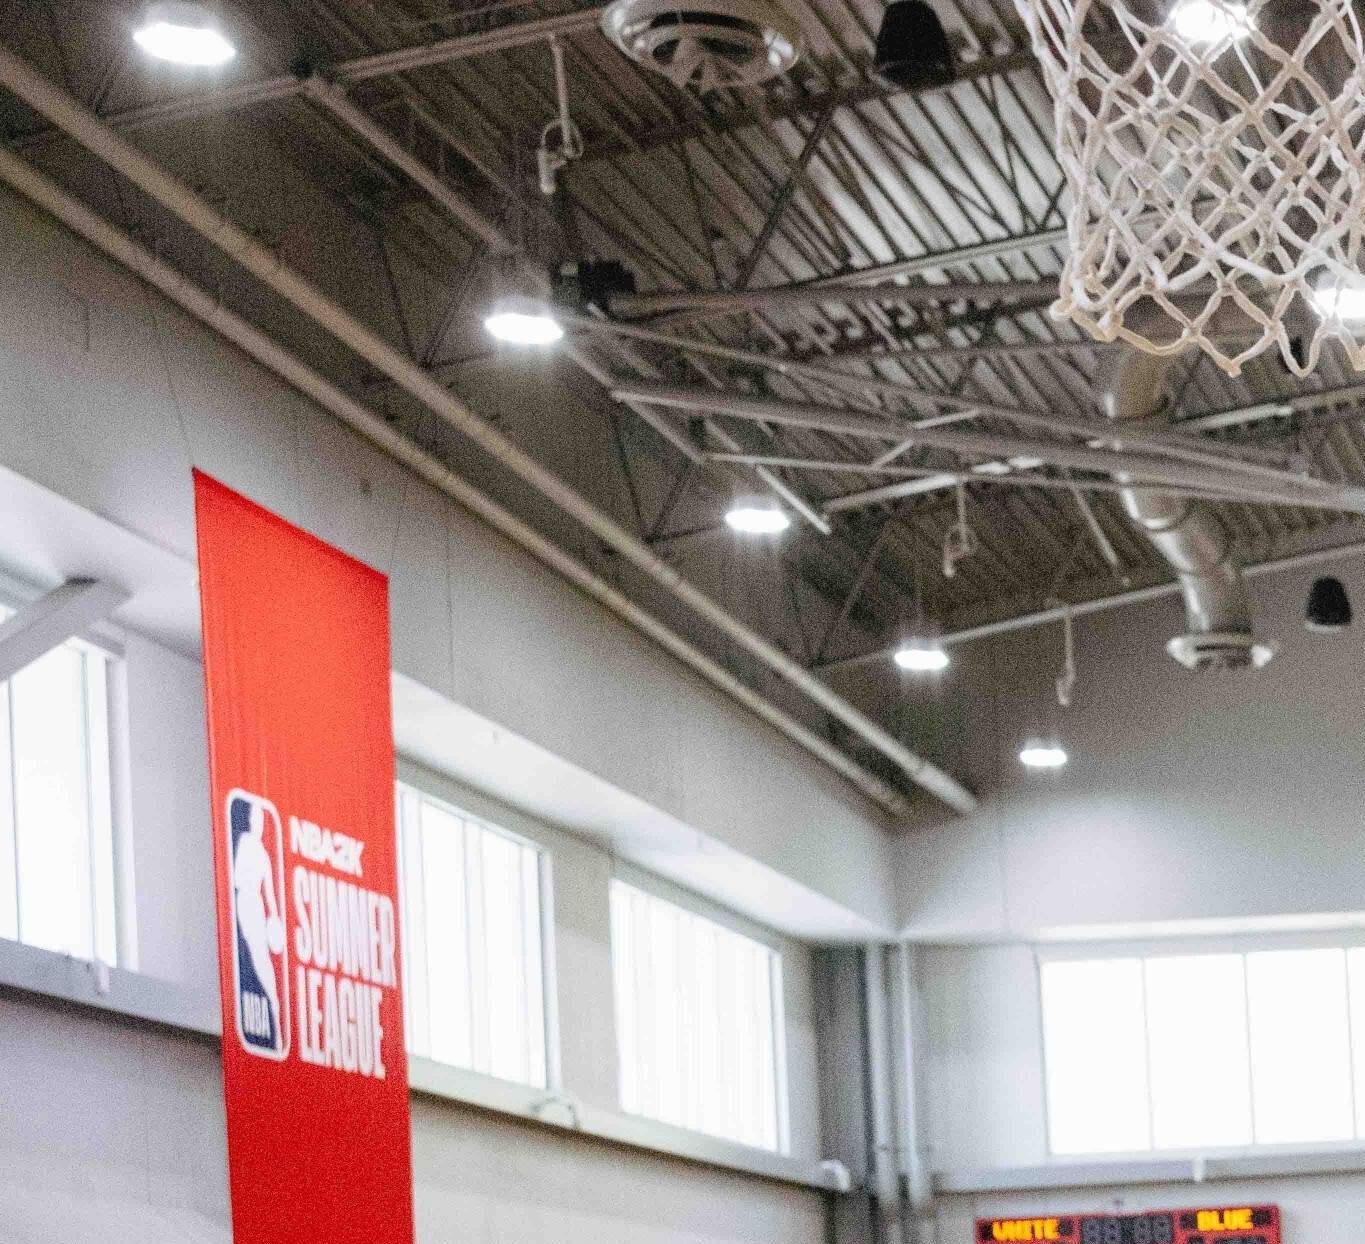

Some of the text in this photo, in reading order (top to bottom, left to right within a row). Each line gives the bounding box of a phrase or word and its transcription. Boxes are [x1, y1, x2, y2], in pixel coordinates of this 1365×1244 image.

[292, 864, 397, 988] SUMMER
[296, 963, 386, 1080] LEAGUE
[992, 1217, 1060, 1241] WHITE
[1196, 1207, 1254, 1232] BLUE
